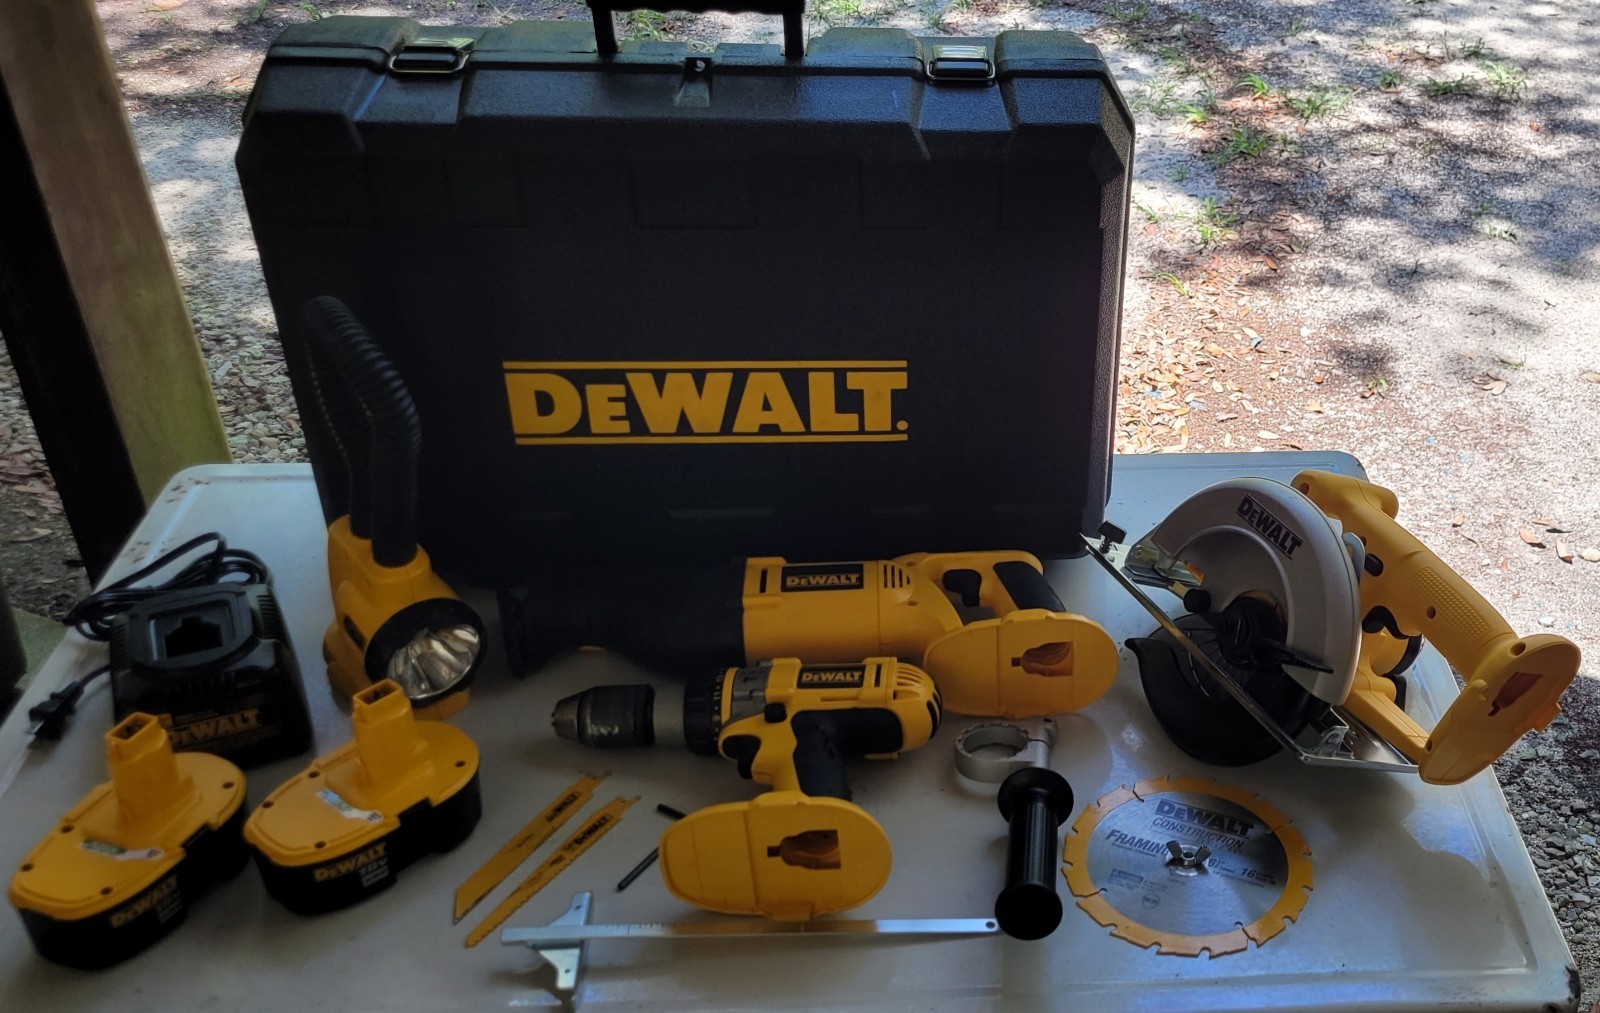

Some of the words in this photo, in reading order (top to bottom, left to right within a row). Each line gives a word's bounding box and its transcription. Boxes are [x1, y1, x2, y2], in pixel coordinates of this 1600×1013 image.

[1238, 496, 1303, 556] DEWALT
[1153, 818, 1246, 850] CONSTRUCTION
[1155, 800, 1255, 837] DEWALT
[313, 841, 387, 884] DEWALT
[1241, 867, 1257, 878] 16
